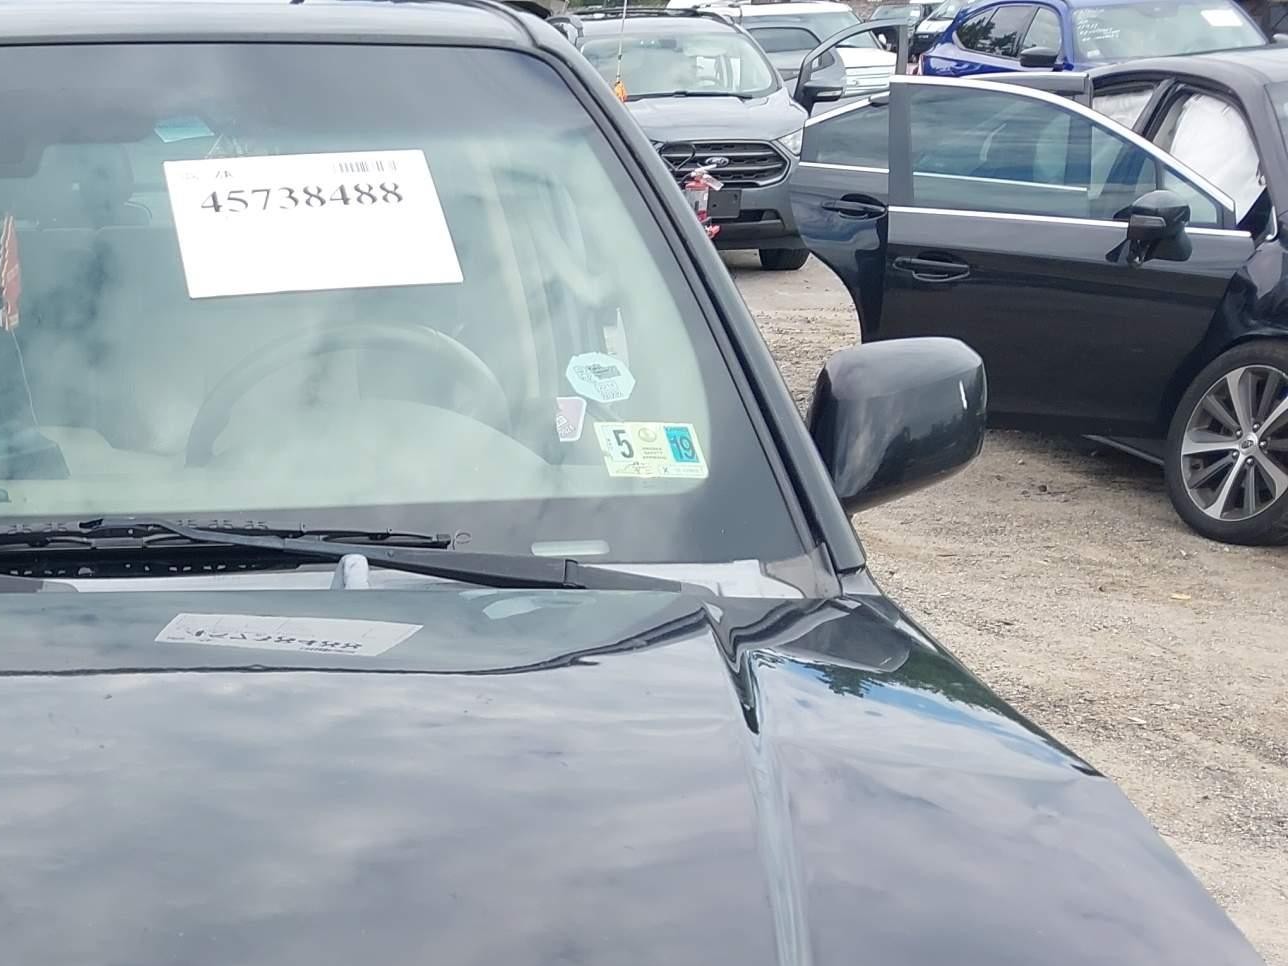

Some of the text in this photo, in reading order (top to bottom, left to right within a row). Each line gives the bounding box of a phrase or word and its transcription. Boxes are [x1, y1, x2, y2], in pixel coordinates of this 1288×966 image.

[200, 181, 404, 213] 45738488
[612, 429, 635, 459] 5
[669, 435, 697, 460] 19
